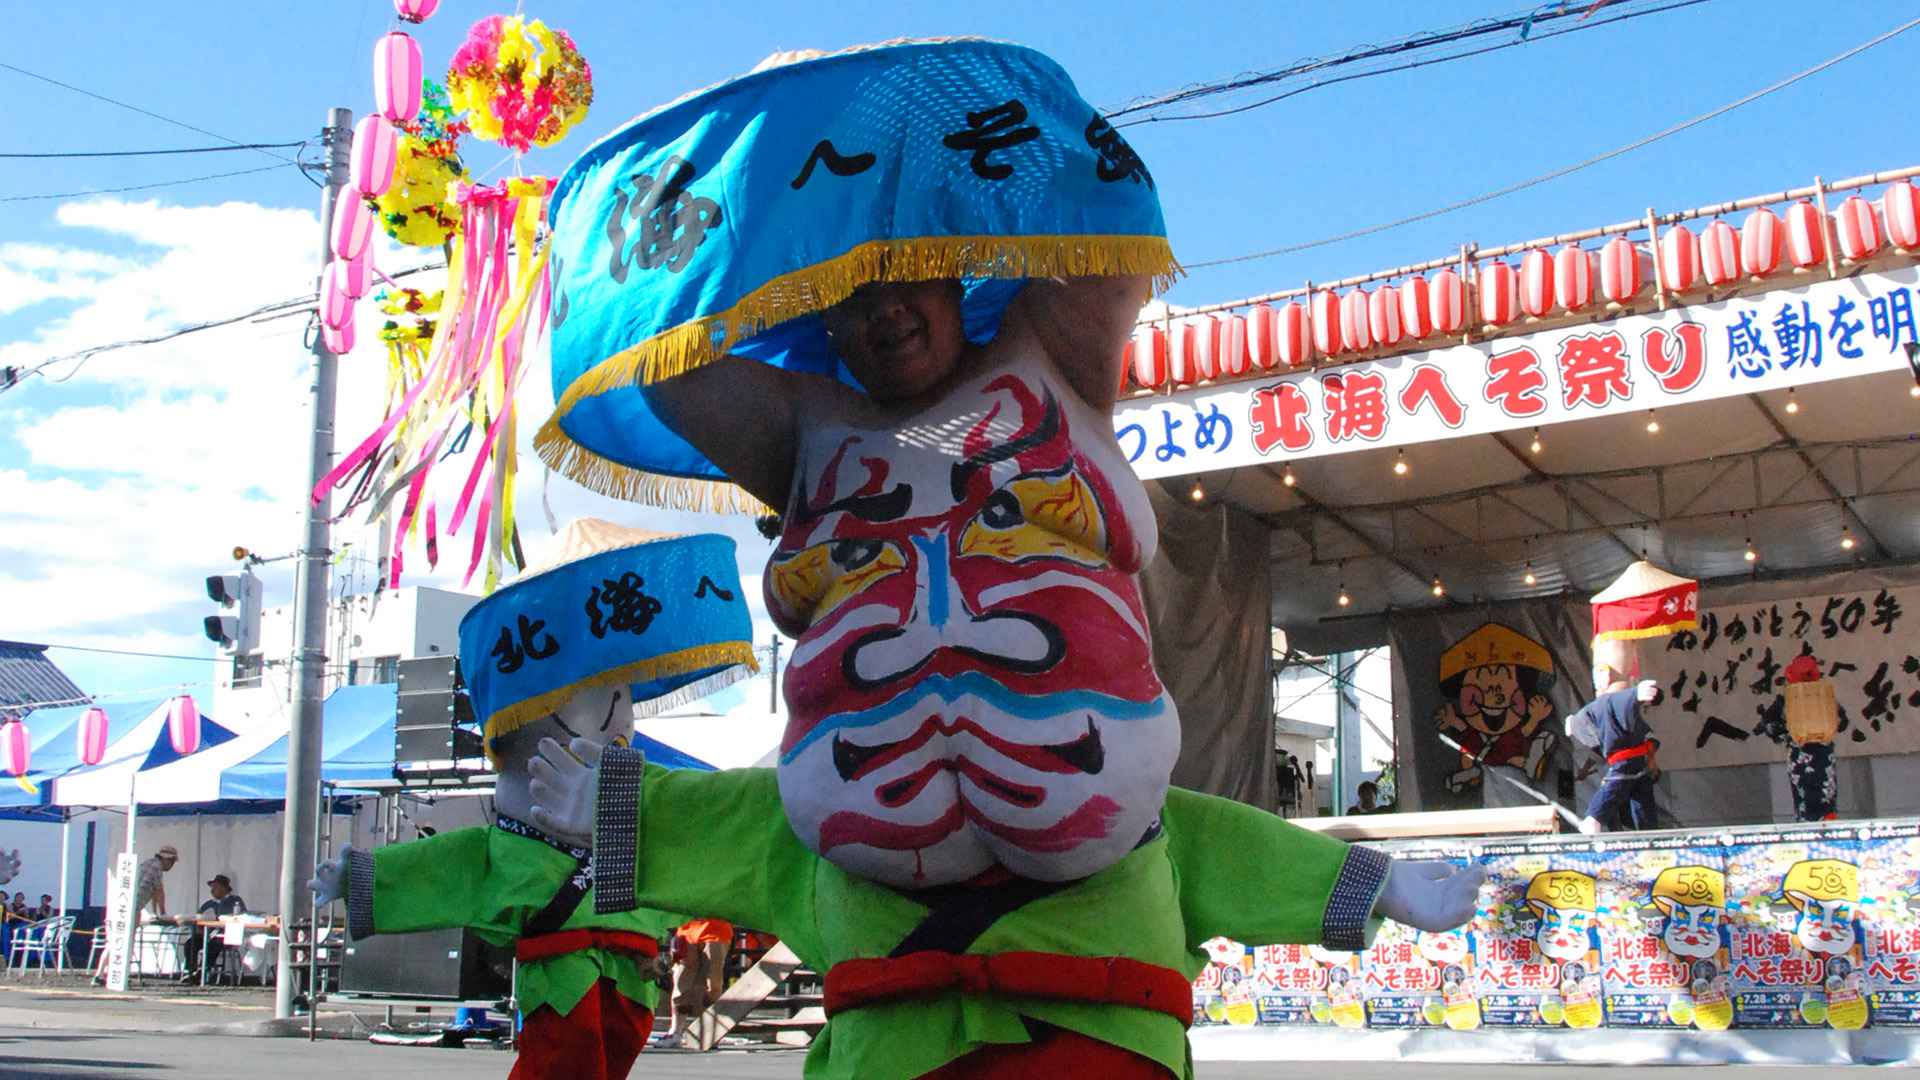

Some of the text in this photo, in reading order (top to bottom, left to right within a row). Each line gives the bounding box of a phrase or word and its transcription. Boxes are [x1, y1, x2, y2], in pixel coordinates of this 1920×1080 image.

[1106, 286, 1920, 463] つよめ 北海へそ祭り 感動を明
[490, 572, 735, 674] 北海へ
[1264, 944, 1301, 964] 北海
[1372, 944, 1412, 964] 北海
[1487, 939, 1531, 960] 北海
[1611, 937, 1657, 959] 北海
[1743, 931, 1790, 957] 北海
[1257, 967, 1327, 989] へそ祭り
[1365, 967, 1439, 988] へそ祭り
[1480, 964, 1558, 986] へそ祭り
[1605, 962, 1689, 985] へそ祭り
[1734, 959, 1823, 983] へそ祭り
[1868, 957, 1920, 980] へそ
